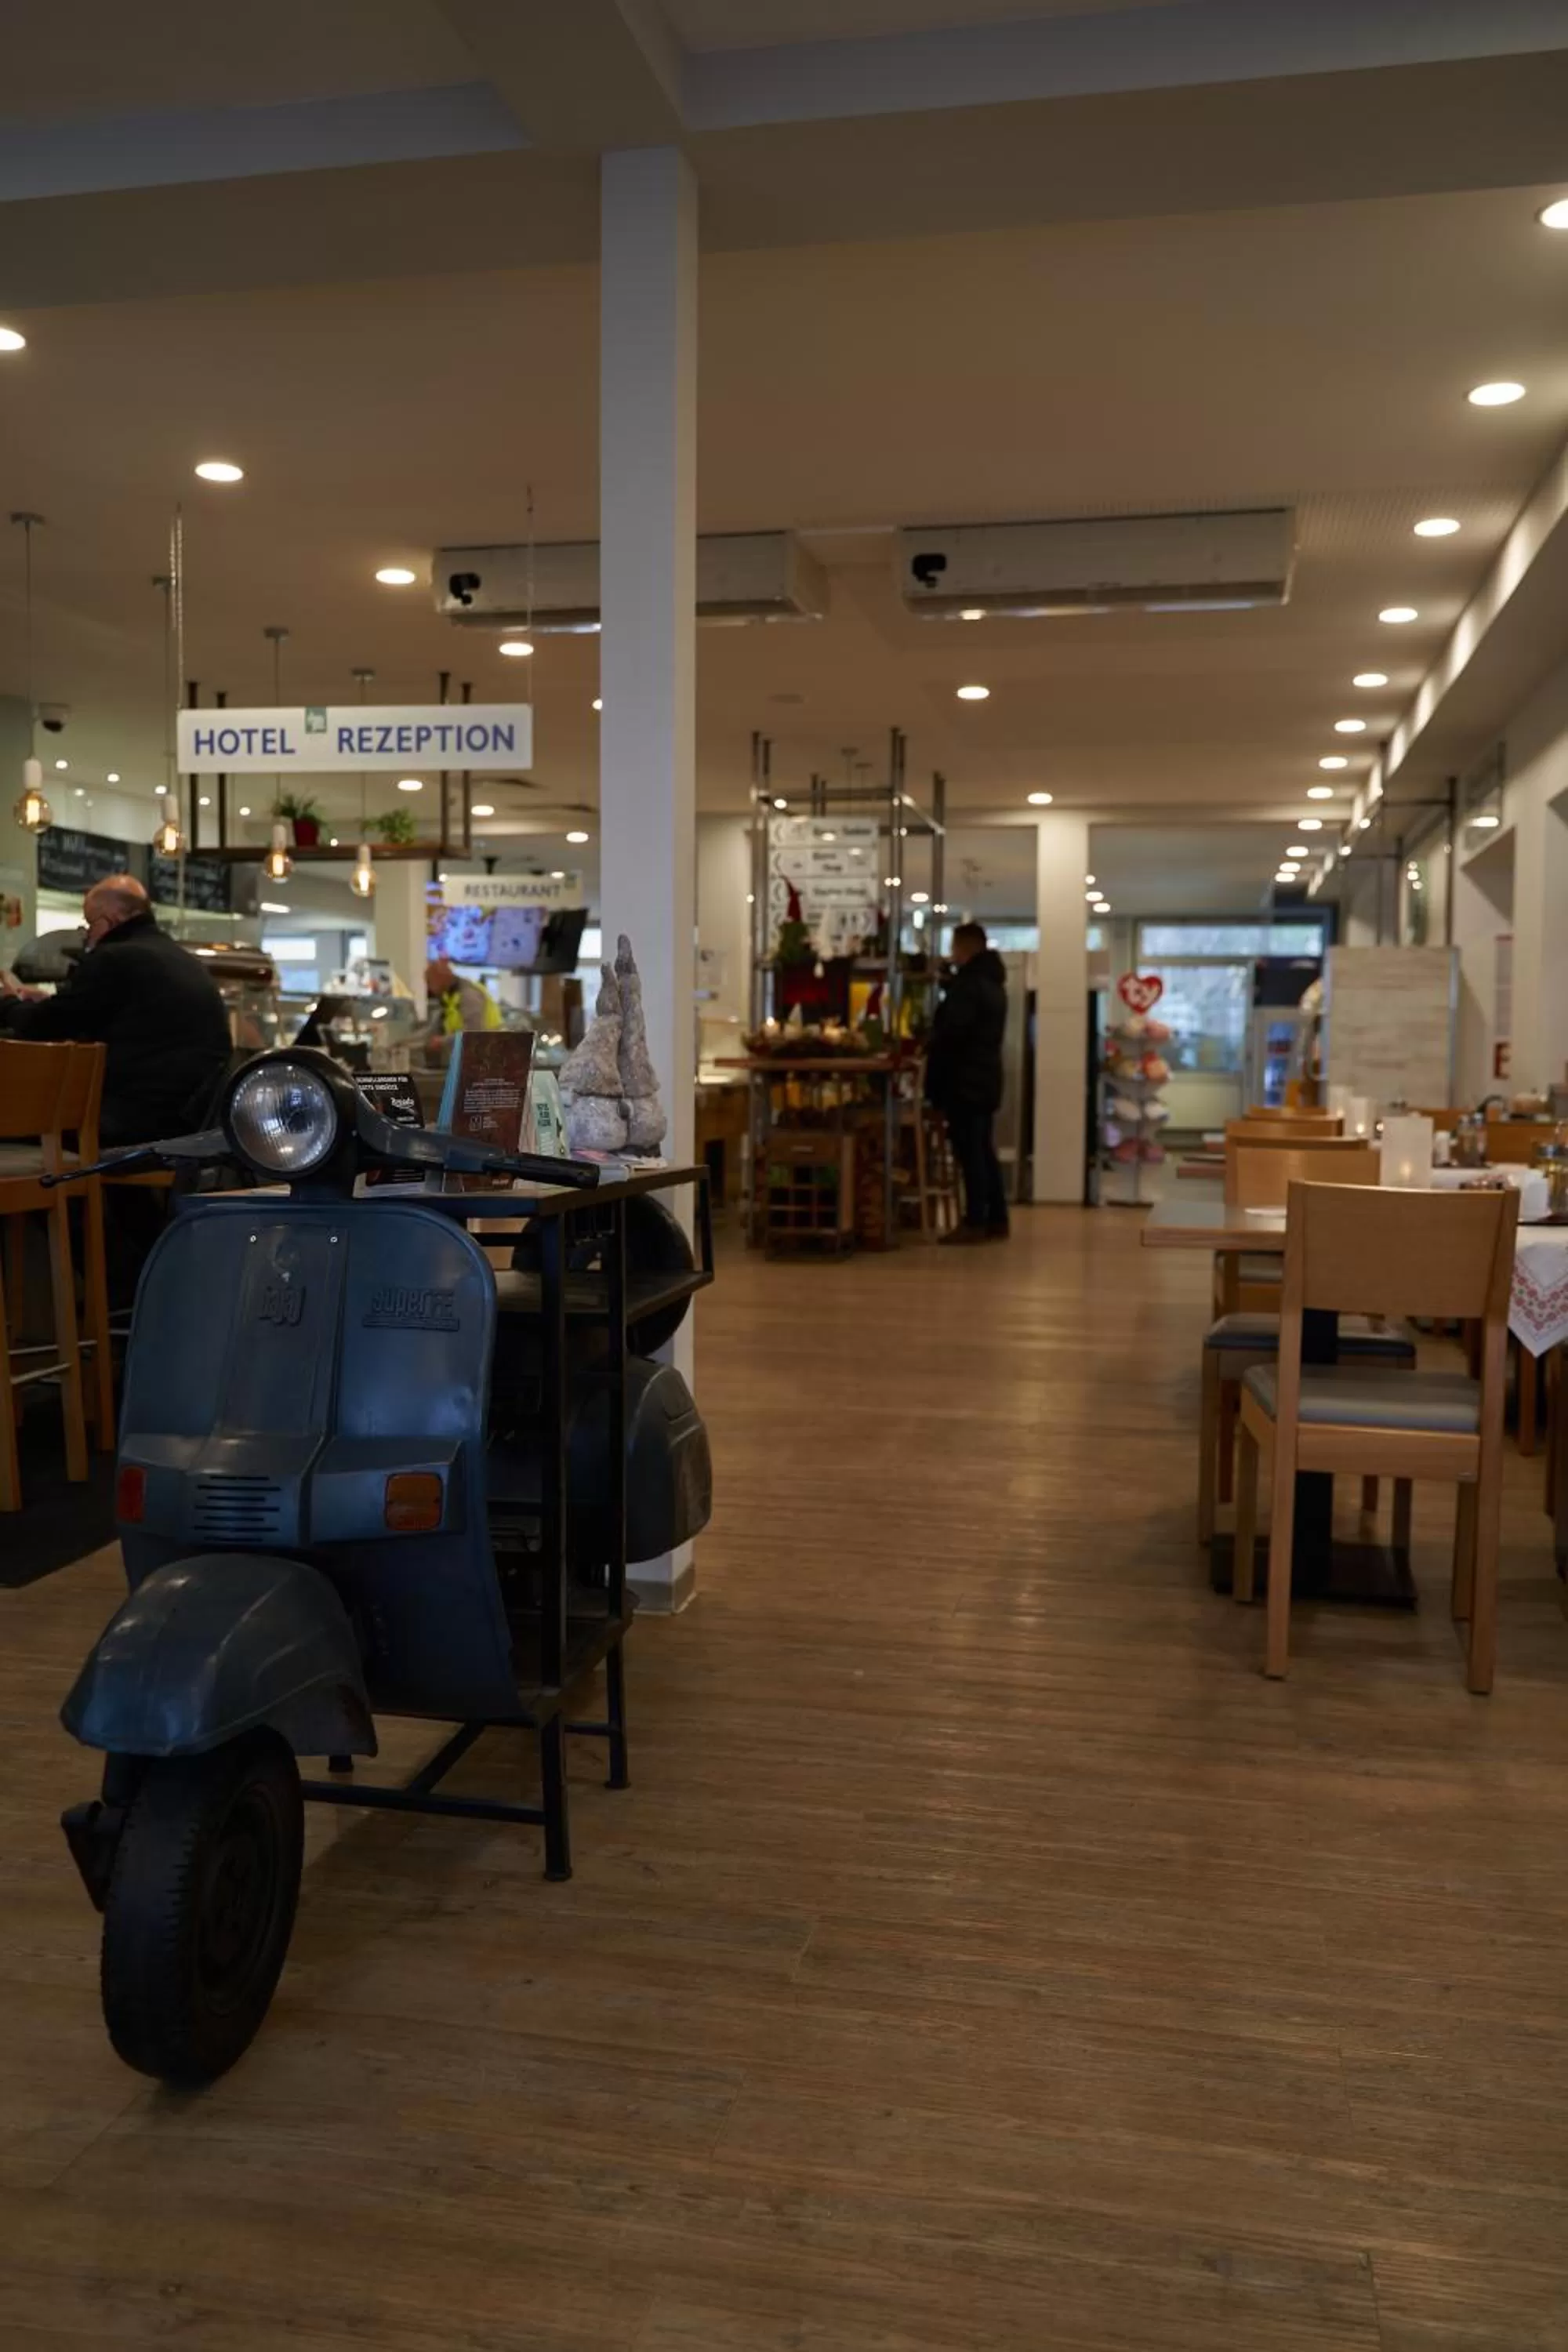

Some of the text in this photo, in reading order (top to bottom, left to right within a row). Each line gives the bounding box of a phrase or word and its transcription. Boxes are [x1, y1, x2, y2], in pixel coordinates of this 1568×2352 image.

[194, 725, 514, 755] HOTEL REZEPTION
[464, 884, 561, 897] RESTAURANT
